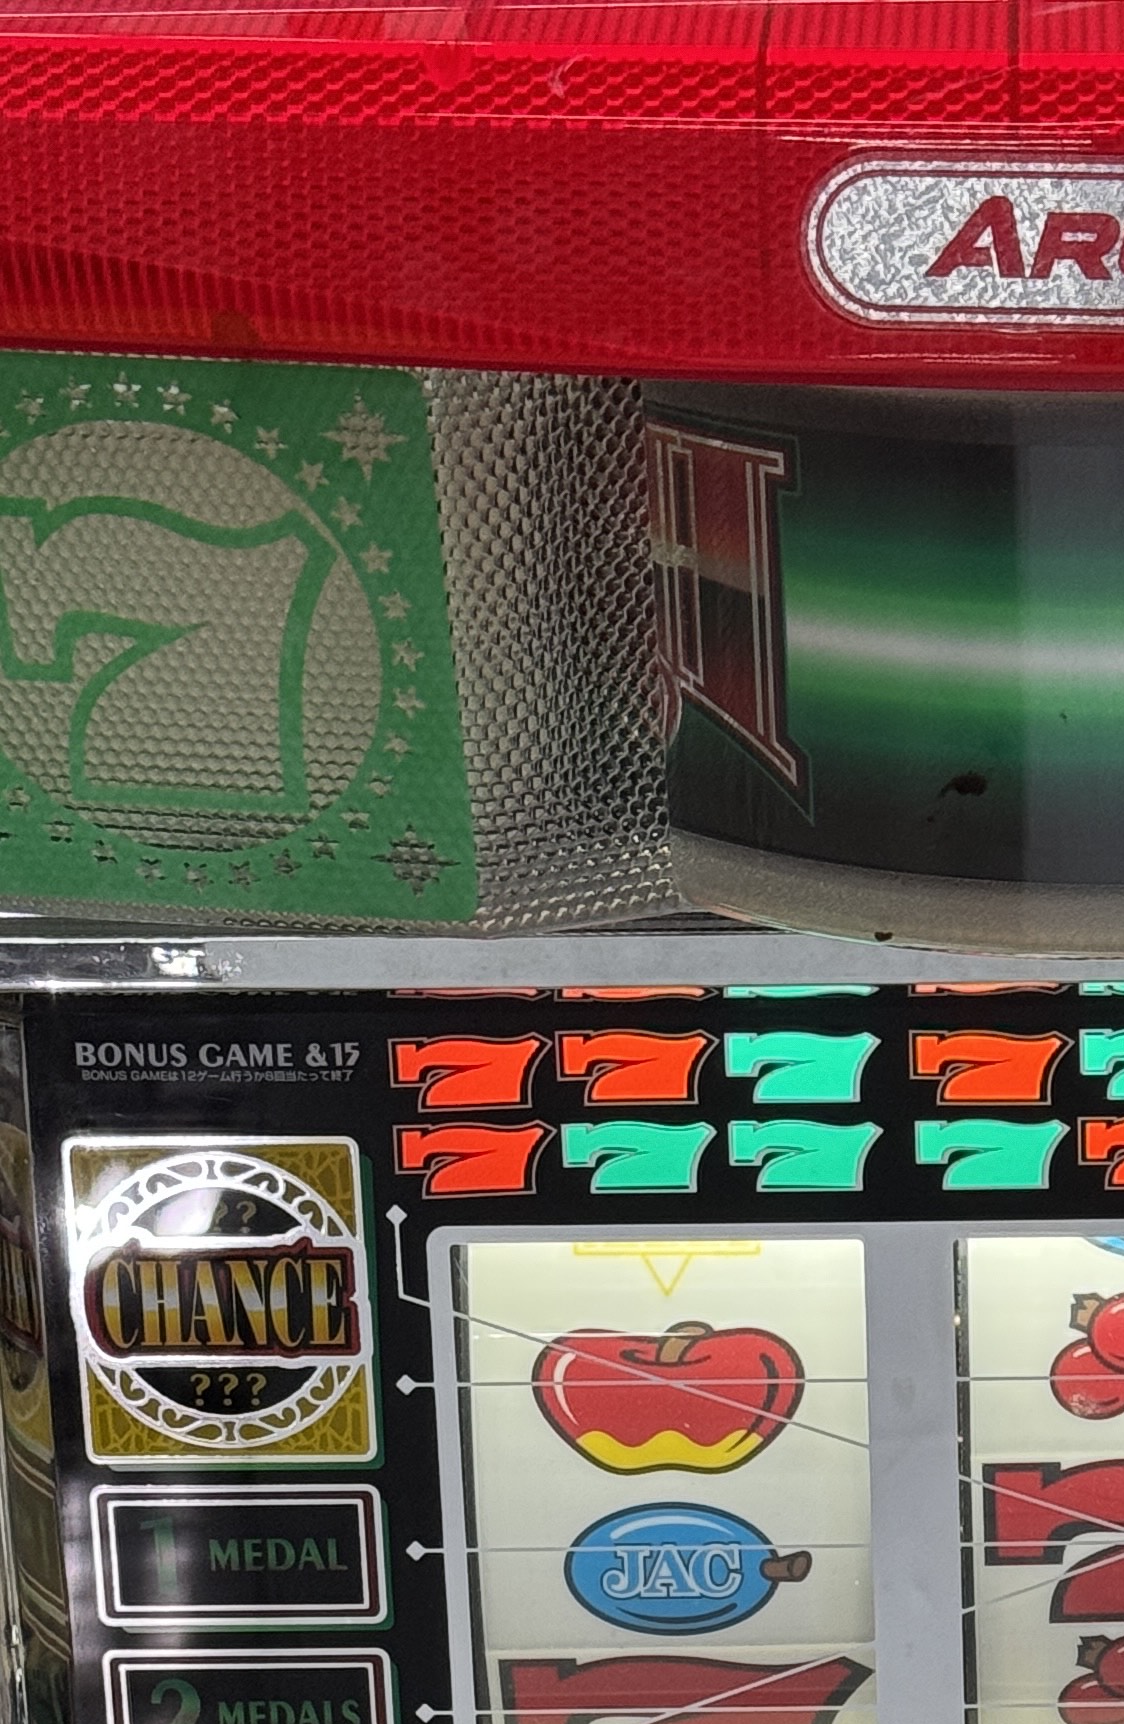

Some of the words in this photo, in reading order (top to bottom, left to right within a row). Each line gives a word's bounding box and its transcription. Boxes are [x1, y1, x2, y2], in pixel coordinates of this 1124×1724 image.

[75, 1042, 187, 1067] BONUS
[199, 1043, 294, 1068] GAME
[82, 1070, 127, 1081] BONUS
[103, 1258, 345, 1348] CHANCE
[141, 1516, 186, 1592] 1
[210, 1538, 348, 1572] MEDAL
[602, 1541, 743, 1599] JAC
